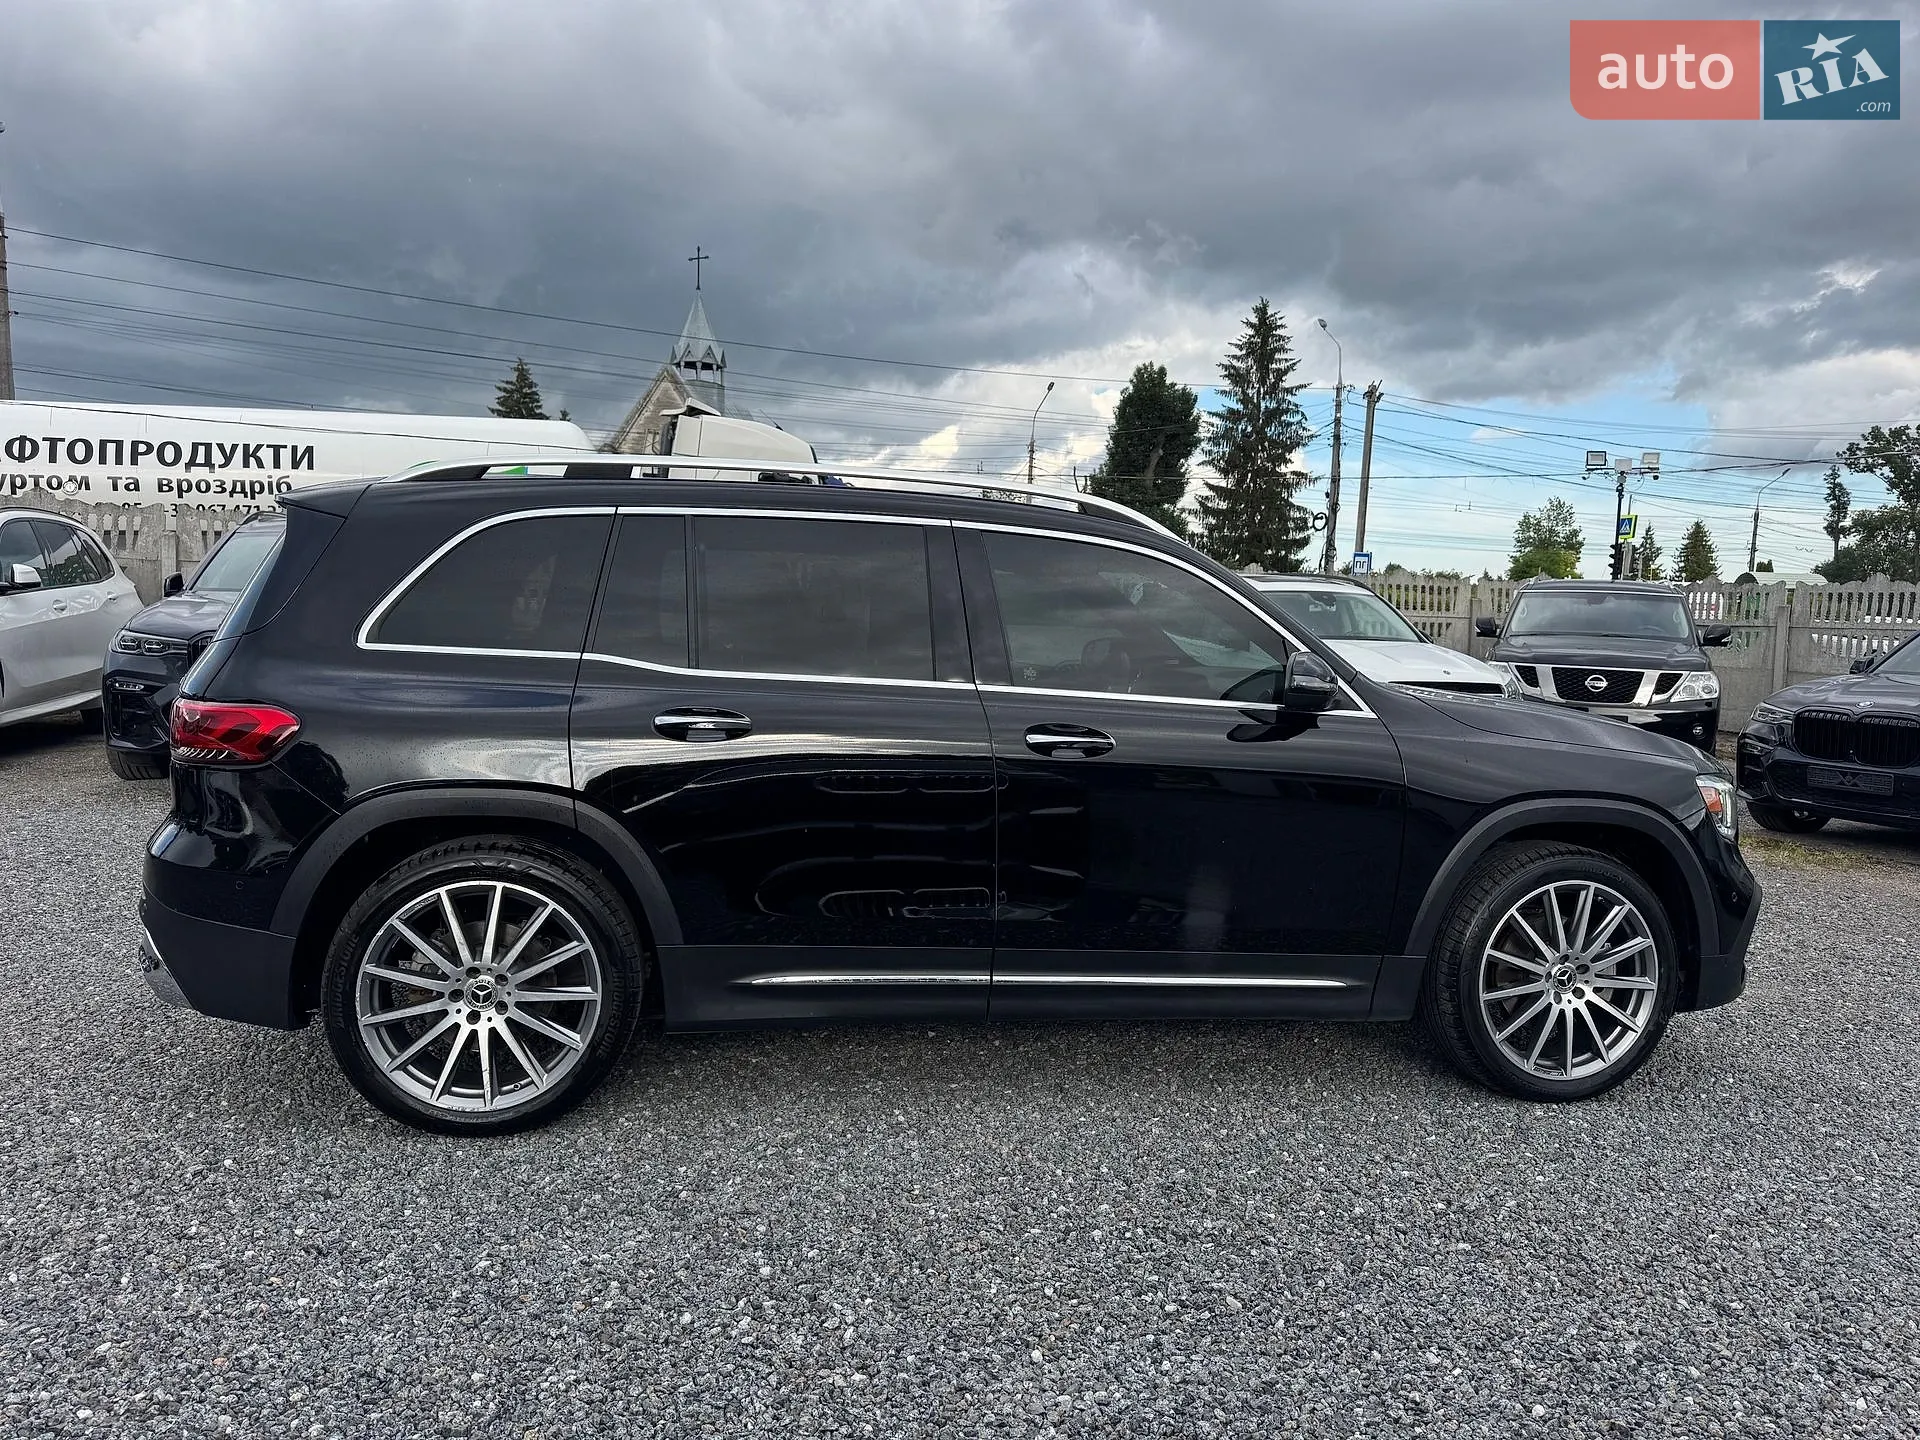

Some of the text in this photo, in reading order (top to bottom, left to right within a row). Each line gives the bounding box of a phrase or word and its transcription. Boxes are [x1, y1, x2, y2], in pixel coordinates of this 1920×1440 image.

[0, 434, 315, 474] ФТОПРОДУКТИ
[107, 476, 141, 492] та
[157, 475, 292, 500] вроздріб
